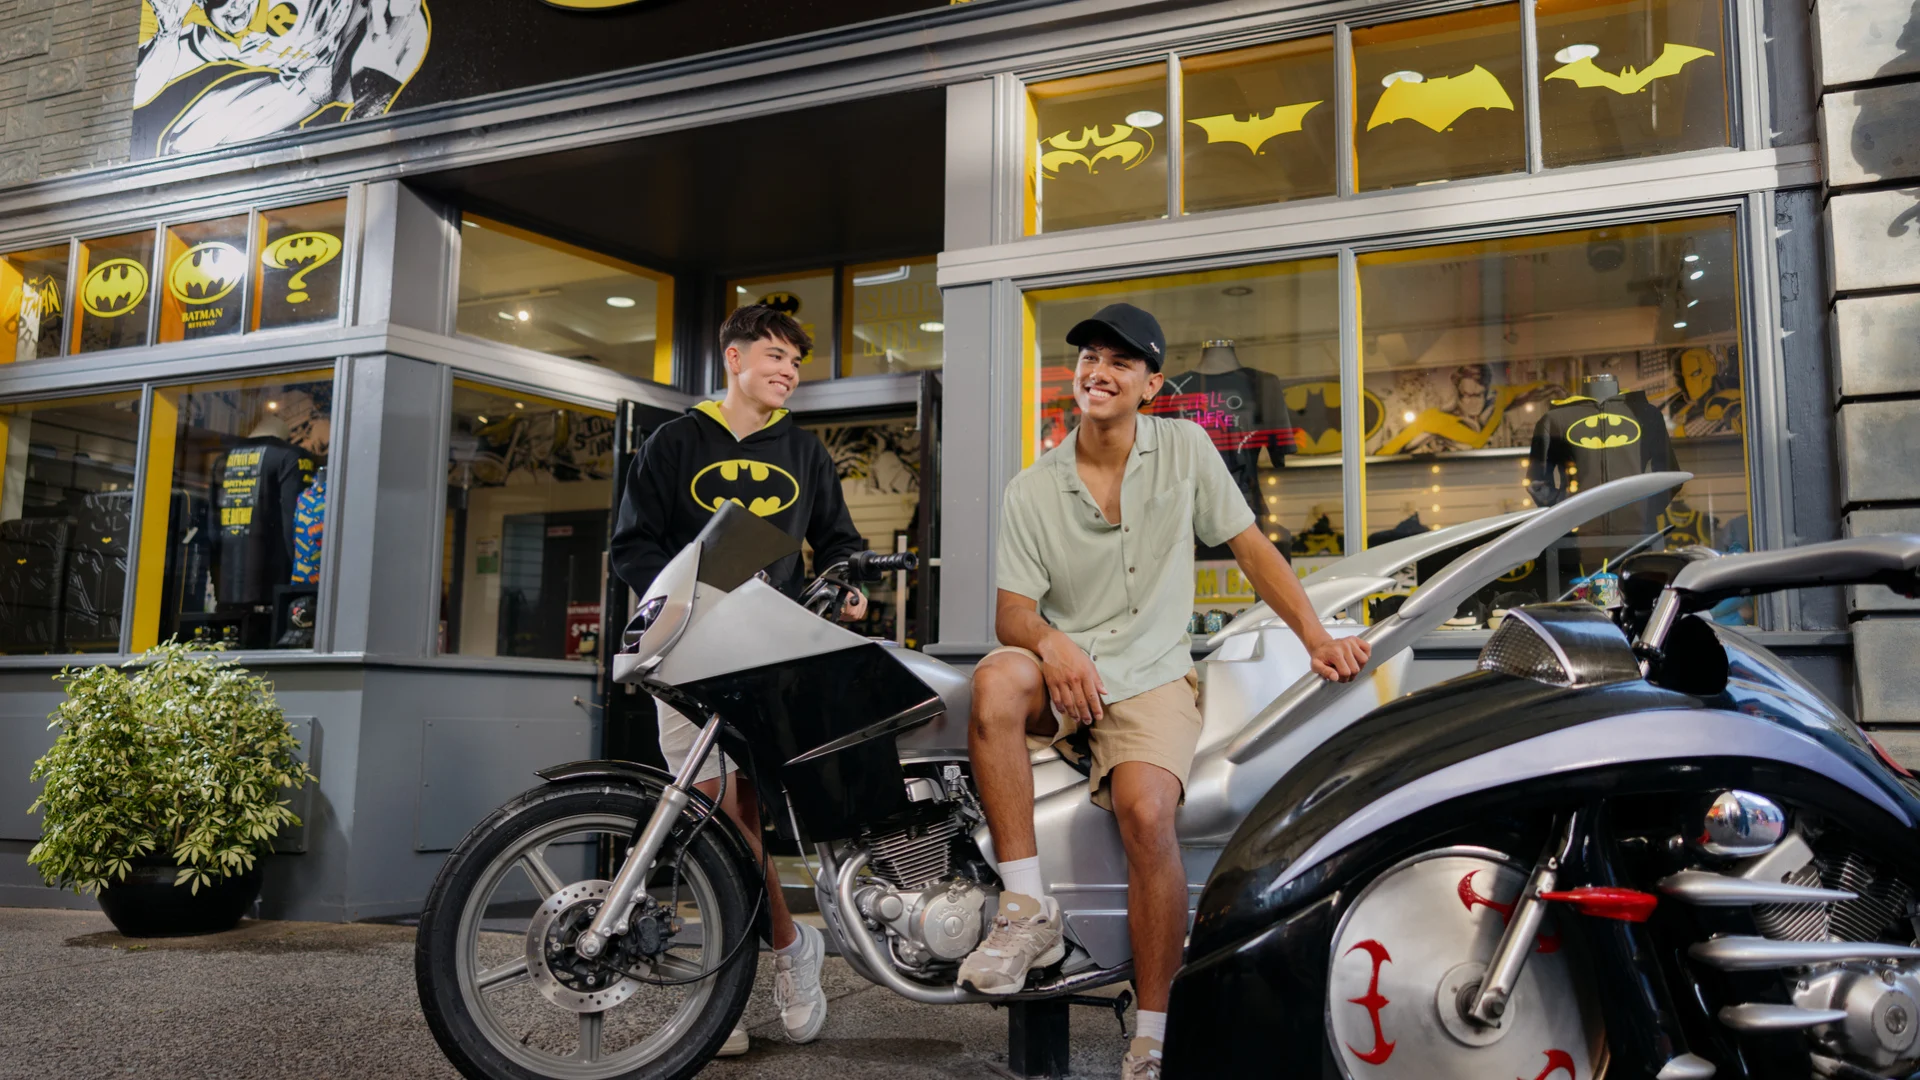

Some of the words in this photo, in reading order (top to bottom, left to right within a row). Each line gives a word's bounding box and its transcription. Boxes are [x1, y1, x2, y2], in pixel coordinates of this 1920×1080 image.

[181, 308, 223, 323] BATMAN
[860, 281, 941, 322] SHOP
[863, 317, 935, 357] NOW
